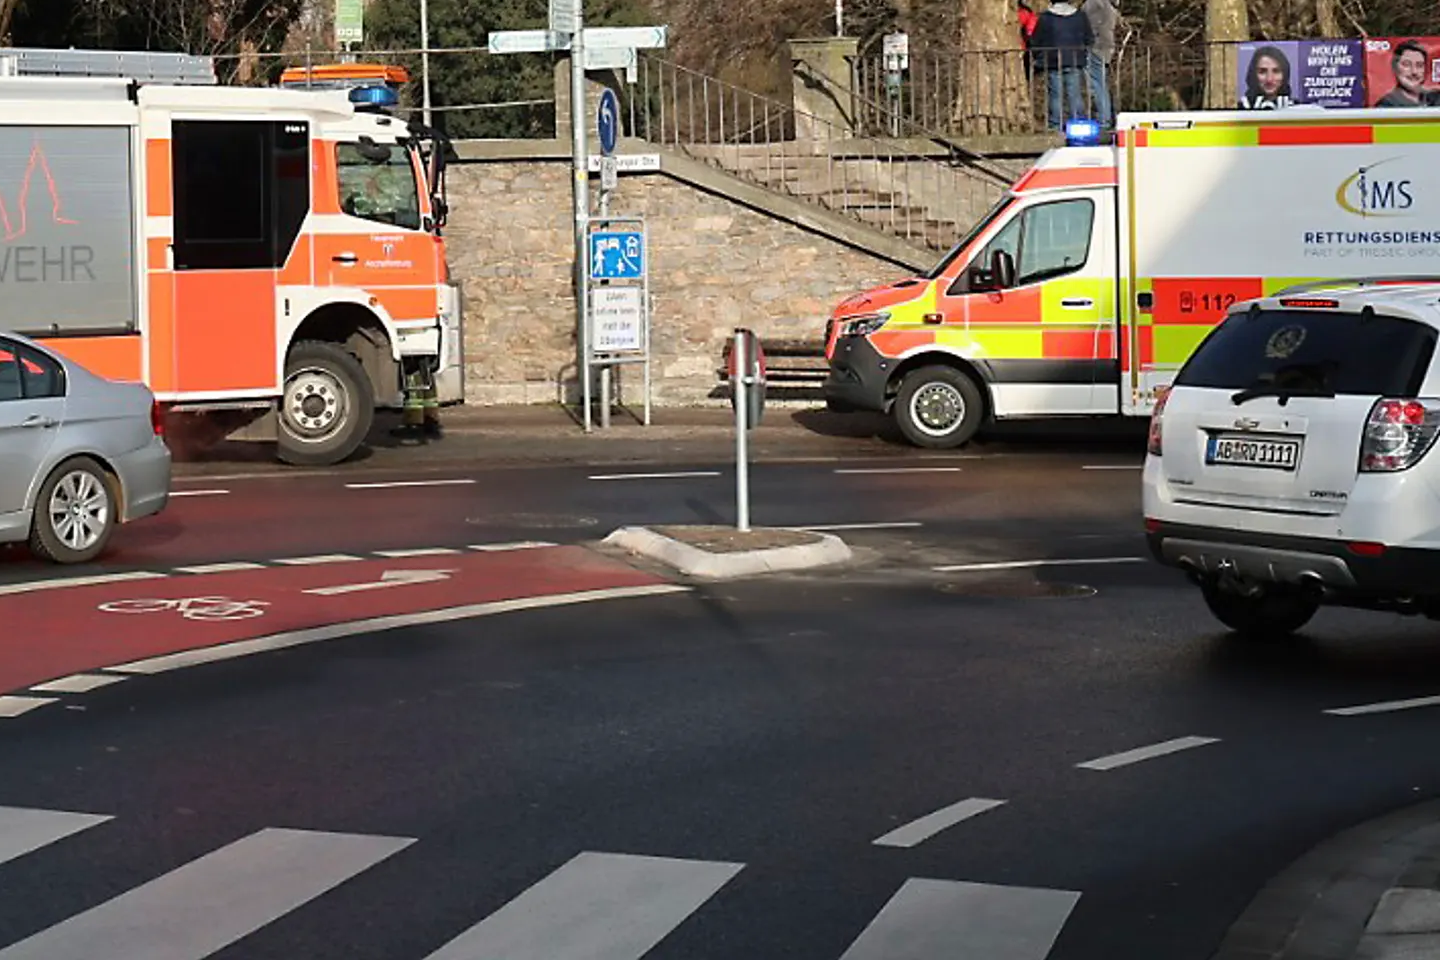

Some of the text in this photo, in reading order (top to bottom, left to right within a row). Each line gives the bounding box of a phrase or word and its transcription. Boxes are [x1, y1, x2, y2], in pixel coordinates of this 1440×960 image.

[1310, 45, 1348, 55] HOLEN
[1329, 55, 1353, 66] UNS
[1320, 67, 1339, 76] DIE
[1304, 77, 1357, 88] ZUKUNFT
[1201, 294, 1237, 311] 112
[1215, 441, 1232, 460] AB
[1260, 444, 1294, 464] 1111
